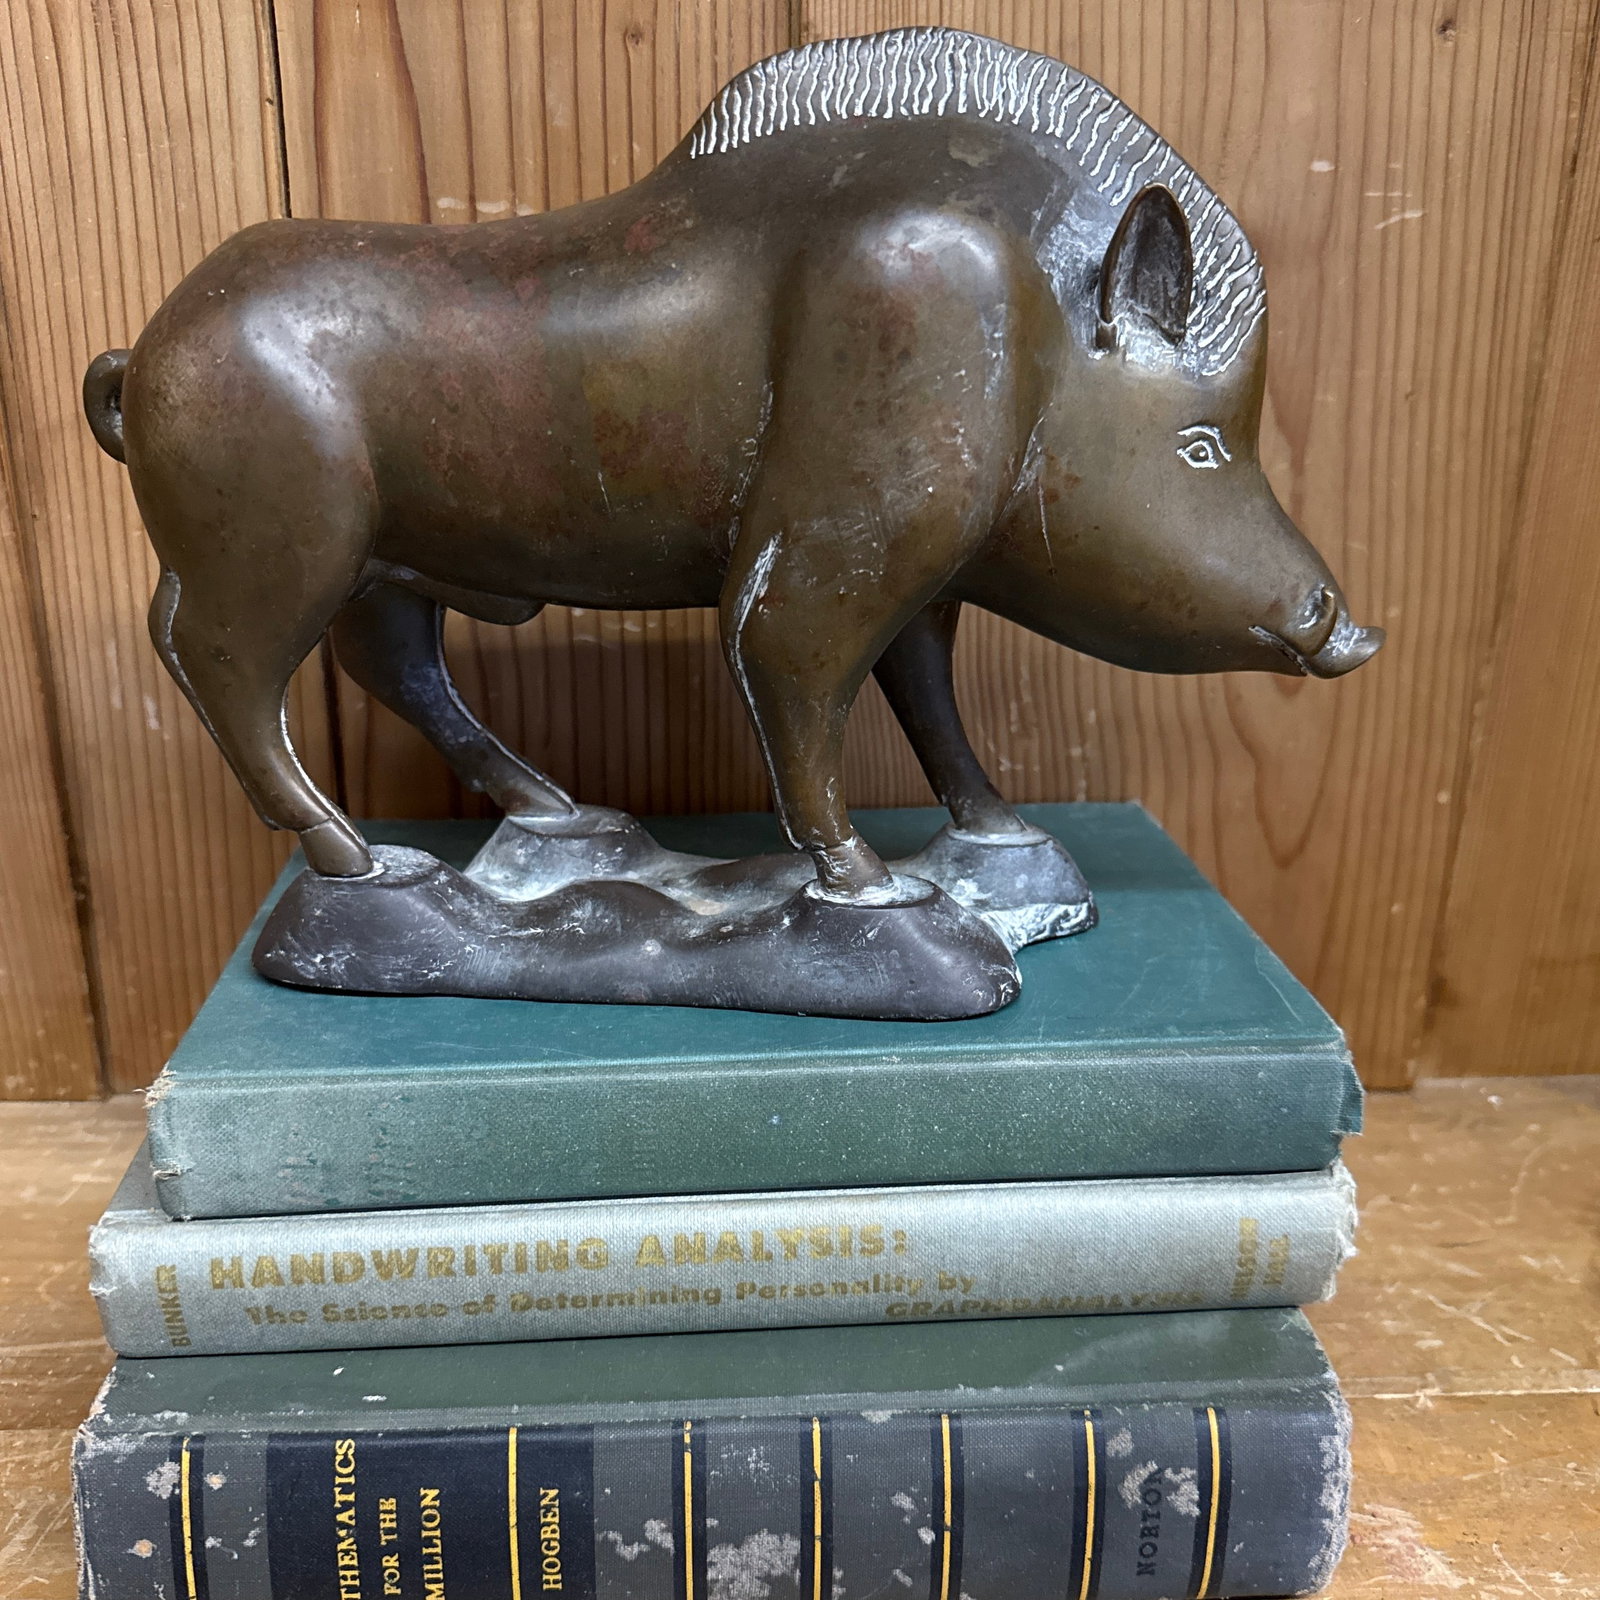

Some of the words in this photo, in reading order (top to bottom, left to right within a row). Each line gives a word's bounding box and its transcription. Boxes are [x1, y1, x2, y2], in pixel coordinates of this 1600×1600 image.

[210, 1238, 608, 1290] HANDWRITING
[635, 1225, 907, 1268] ANALYSIS:
[156, 1264, 192, 1347] BUNKER
[244, 1304, 308, 1325] The
[321, 1300, 449, 1323] Science
[462, 1294, 496, 1316] of
[511, 1284, 721, 1313] Determining
[735, 1273, 924, 1300] Personality
[938, 1270, 975, 1294] by
[379, 1497, 398, 1546] THE
[540, 1487, 563, 1591] HOGBEN
[1136, 1467, 1162, 1576] NORTON
[382, 1553, 402, 1595] FOR
